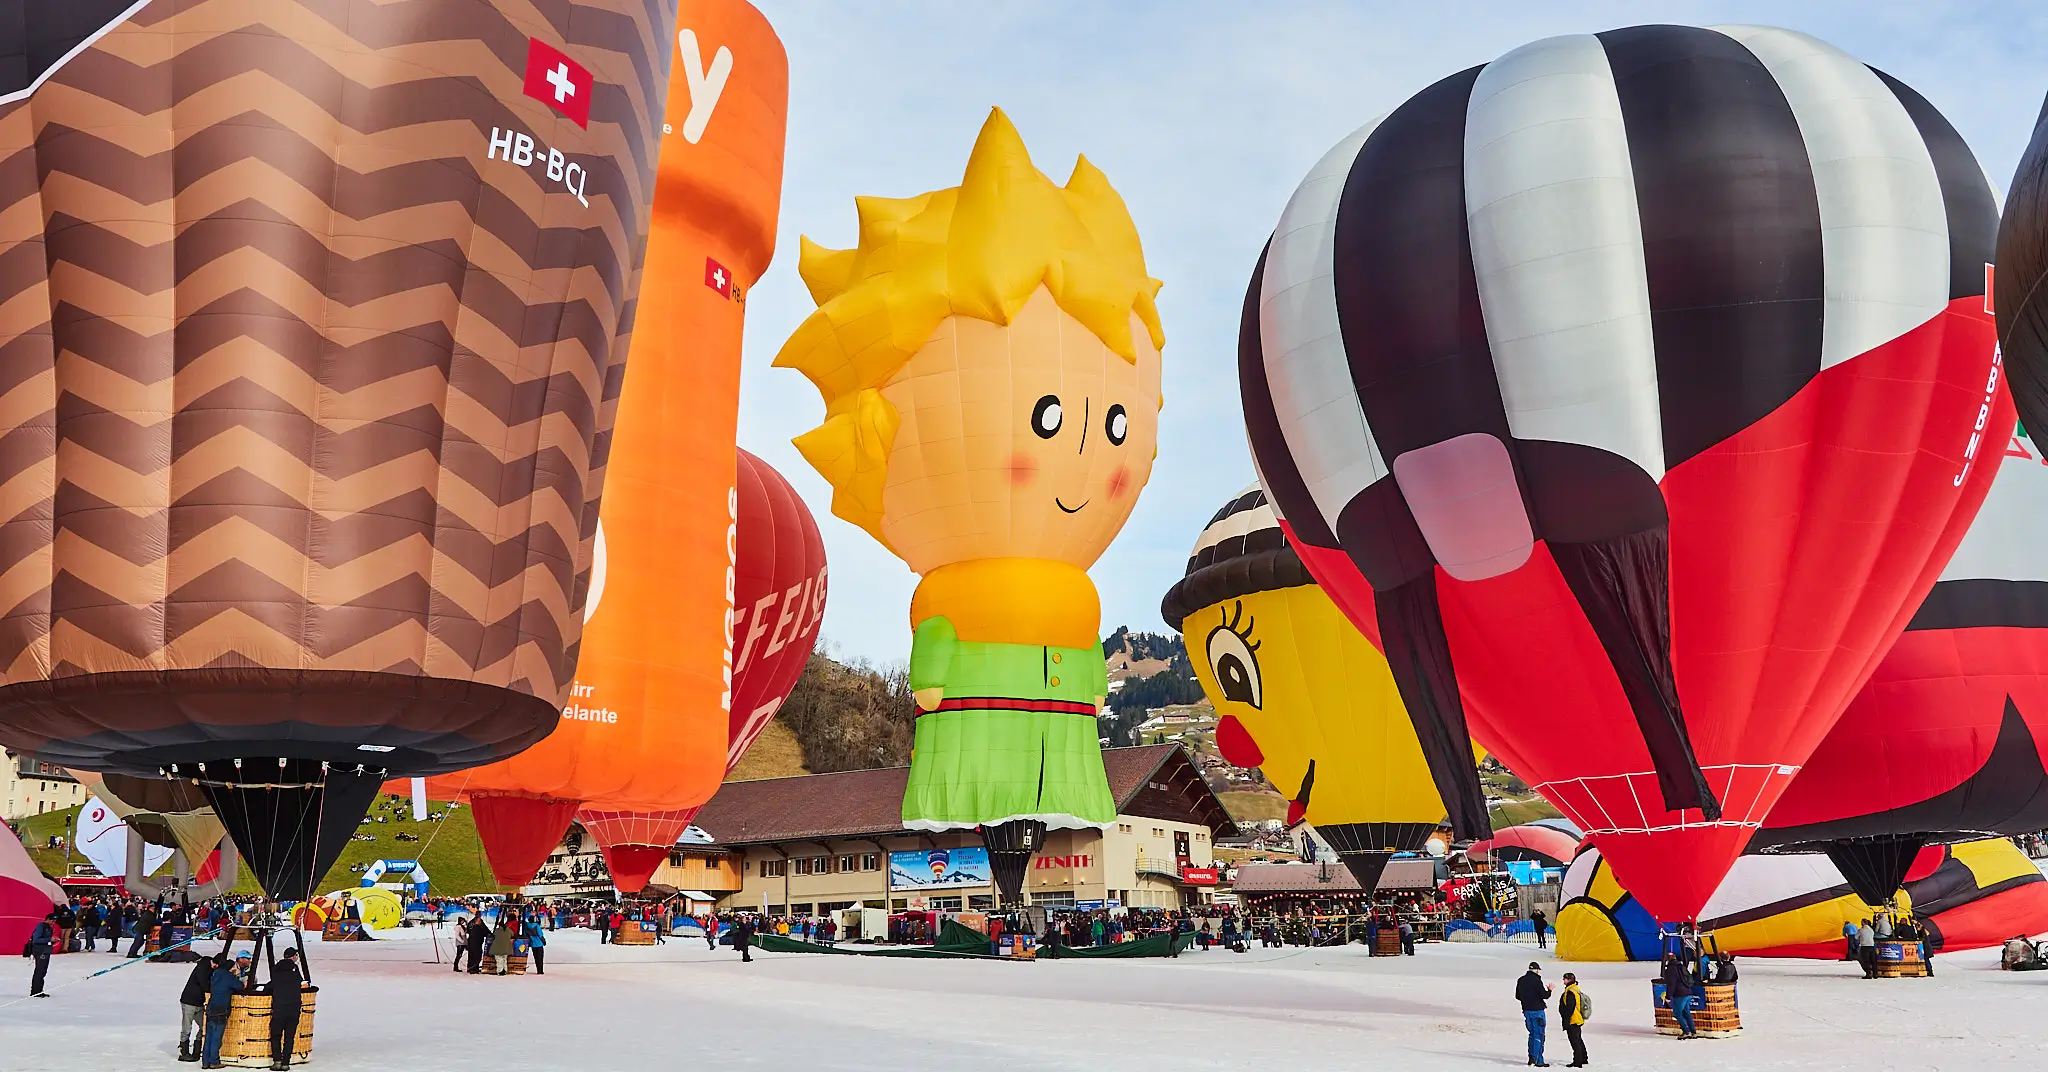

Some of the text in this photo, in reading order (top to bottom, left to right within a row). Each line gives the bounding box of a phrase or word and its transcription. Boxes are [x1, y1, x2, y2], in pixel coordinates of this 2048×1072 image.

[487, 126, 589, 209] HB-BCL
[570, 680, 595, 698] irr
[562, 703, 618, 724] elante
[1034, 854, 1094, 870] ZENITH
